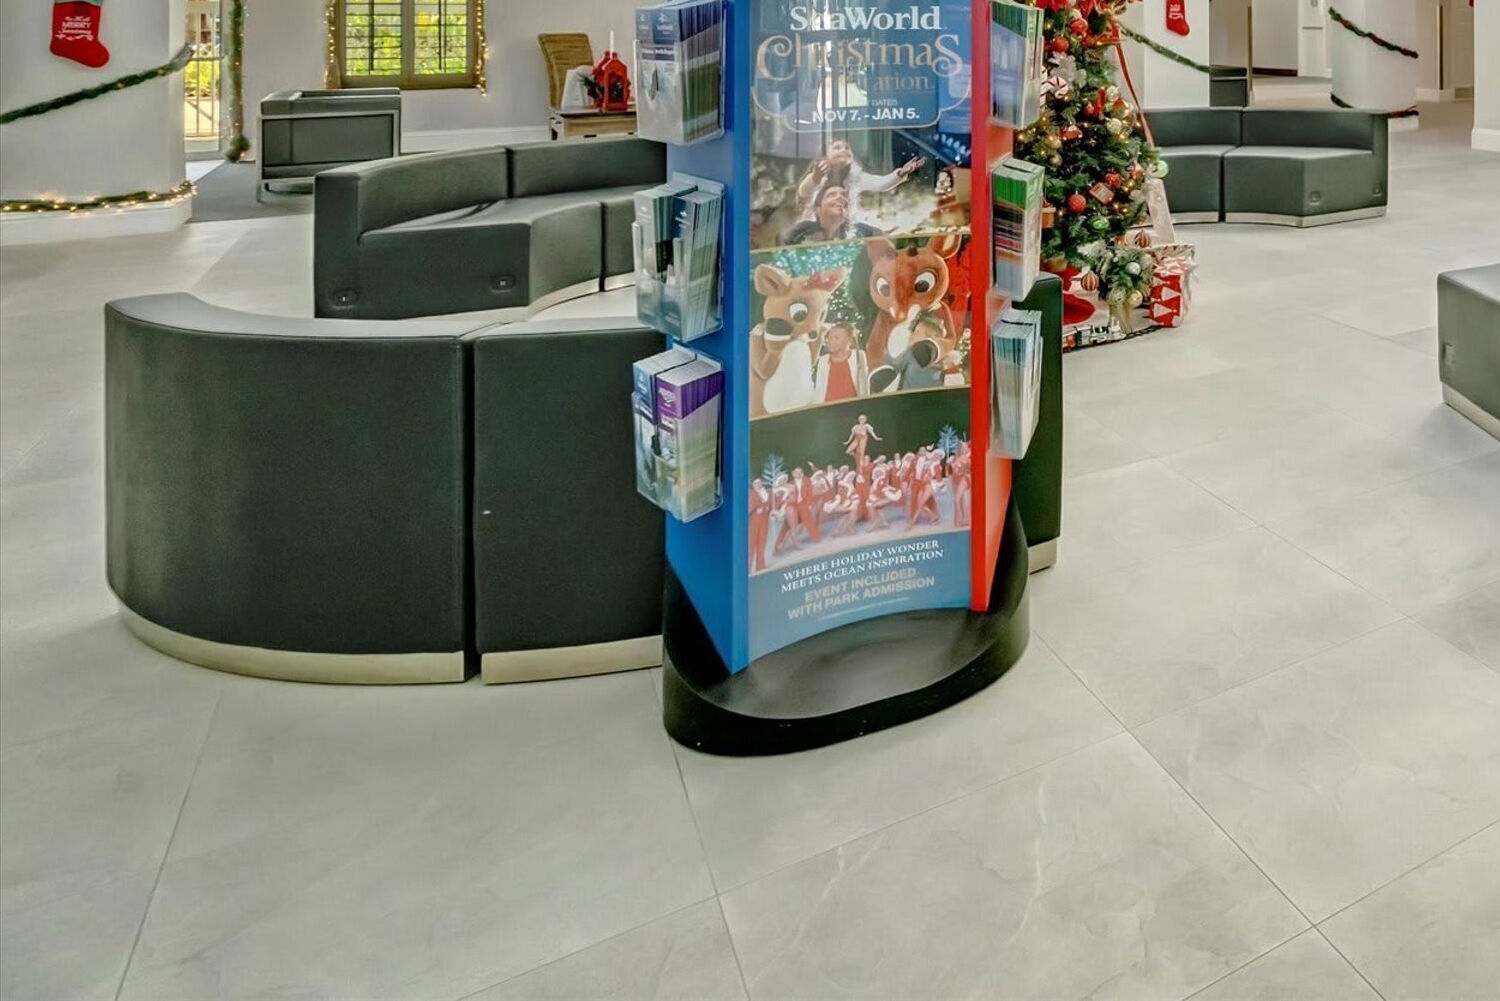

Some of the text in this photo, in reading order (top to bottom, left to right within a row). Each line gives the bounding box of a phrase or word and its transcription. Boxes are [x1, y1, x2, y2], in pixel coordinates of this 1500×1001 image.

[812, 109, 847, 122] NOV
[872, 107, 904, 120] JAN
[781, 549, 944, 593] MEETS OCEAN INSPIRATION
[783, 539, 939, 581] WHERE HOLIDAY WONDER
[787, 576, 936, 620] WITH PARK ADMISSION
[804, 567, 917, 603] EVENT INCLUDED
